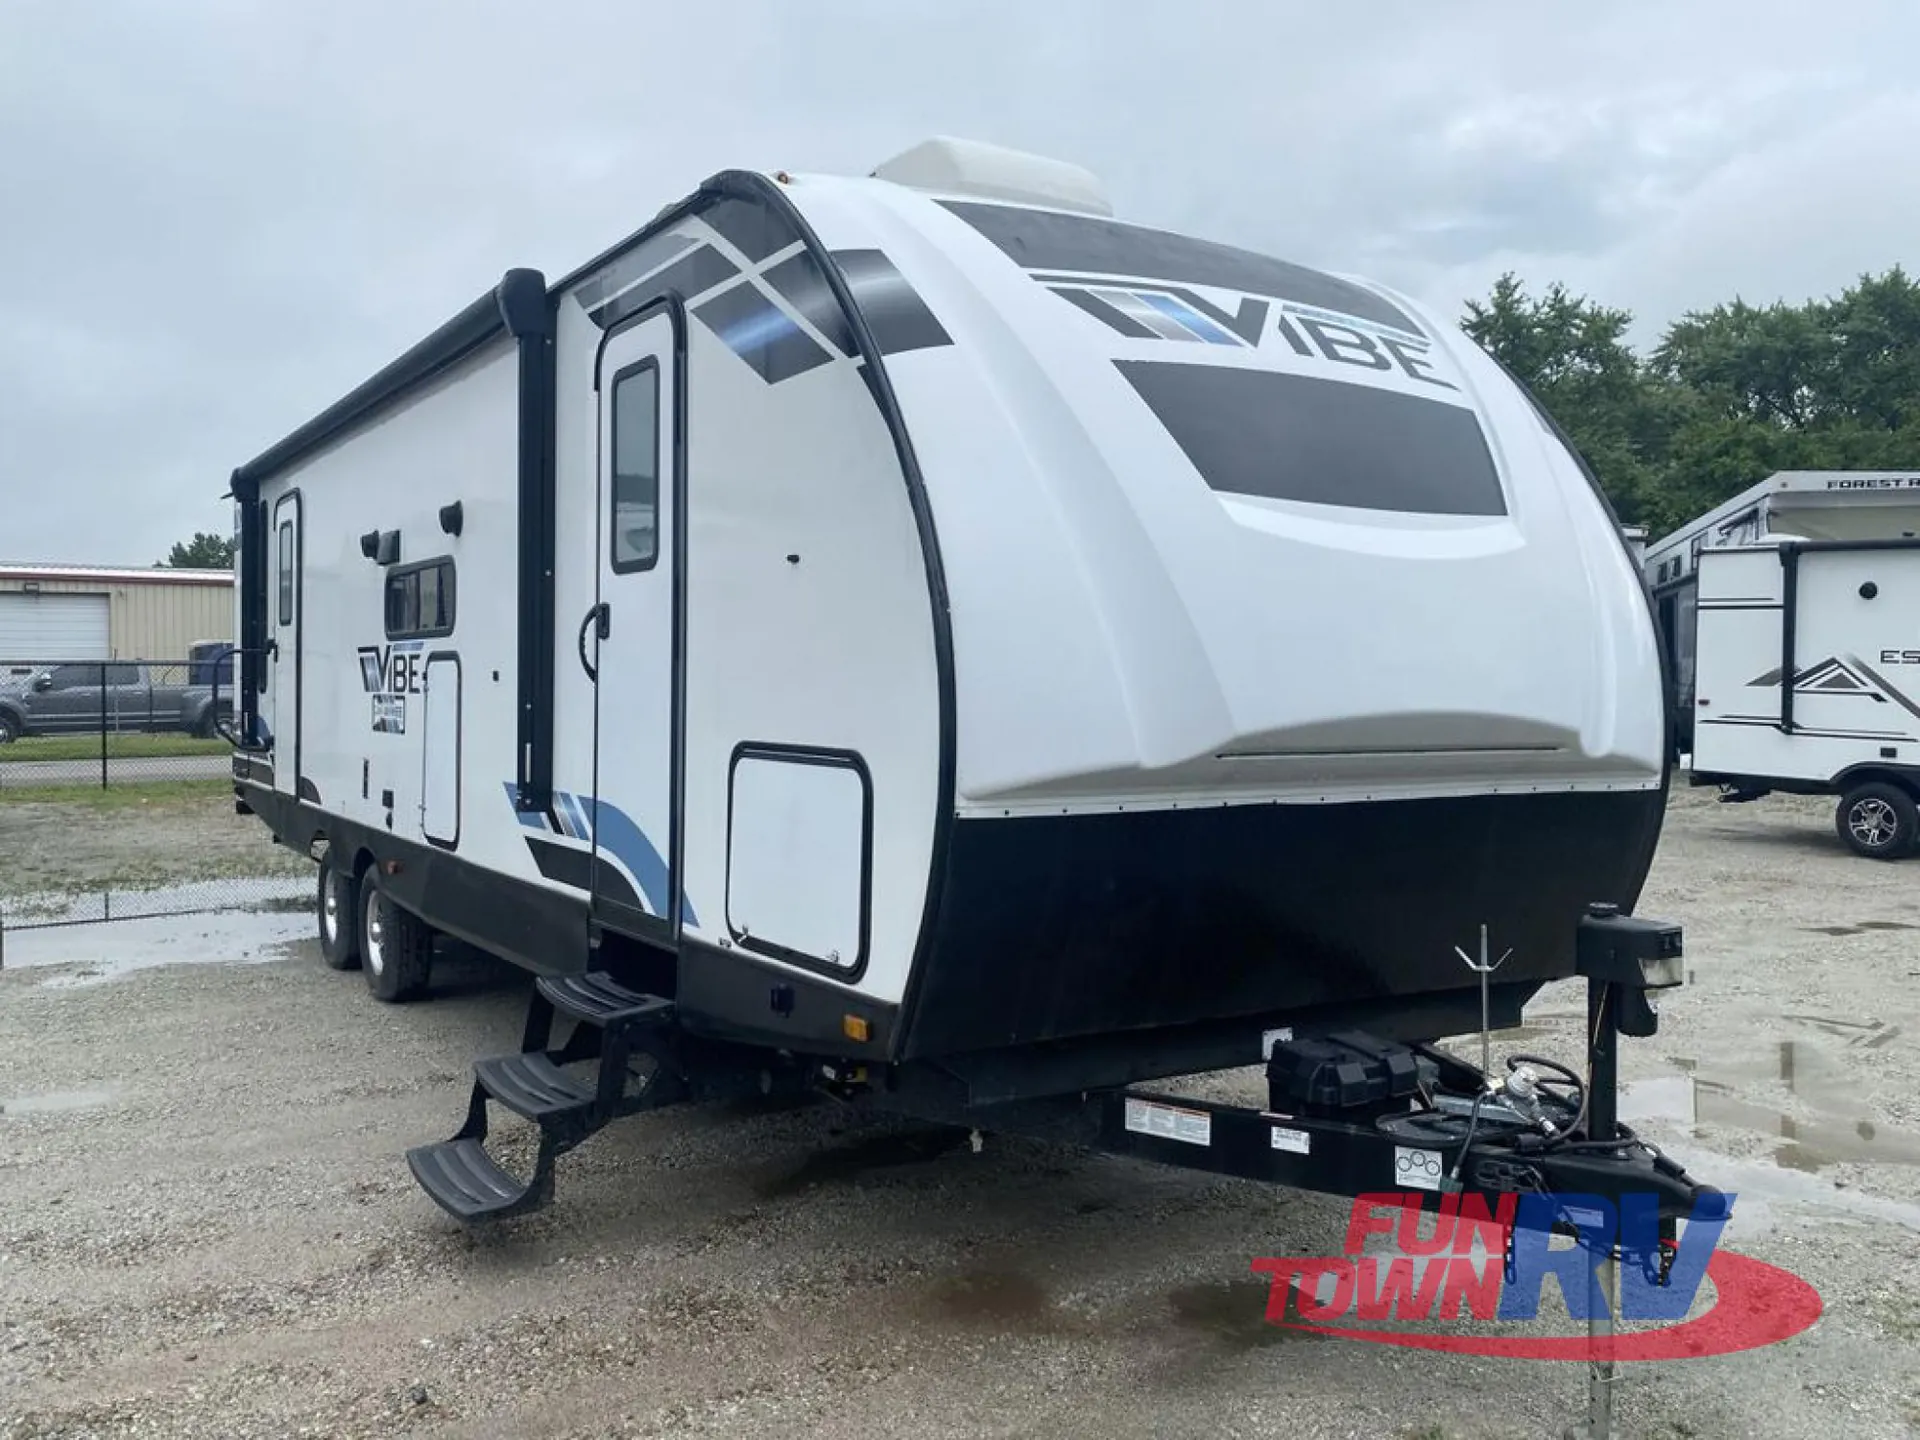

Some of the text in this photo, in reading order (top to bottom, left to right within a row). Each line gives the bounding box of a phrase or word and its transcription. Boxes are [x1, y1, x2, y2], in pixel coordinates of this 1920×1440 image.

[1029, 274, 1462, 392] VIBE
[1827, 478, 1904, 489] FOREST
[358, 644, 421, 694] VIBE
